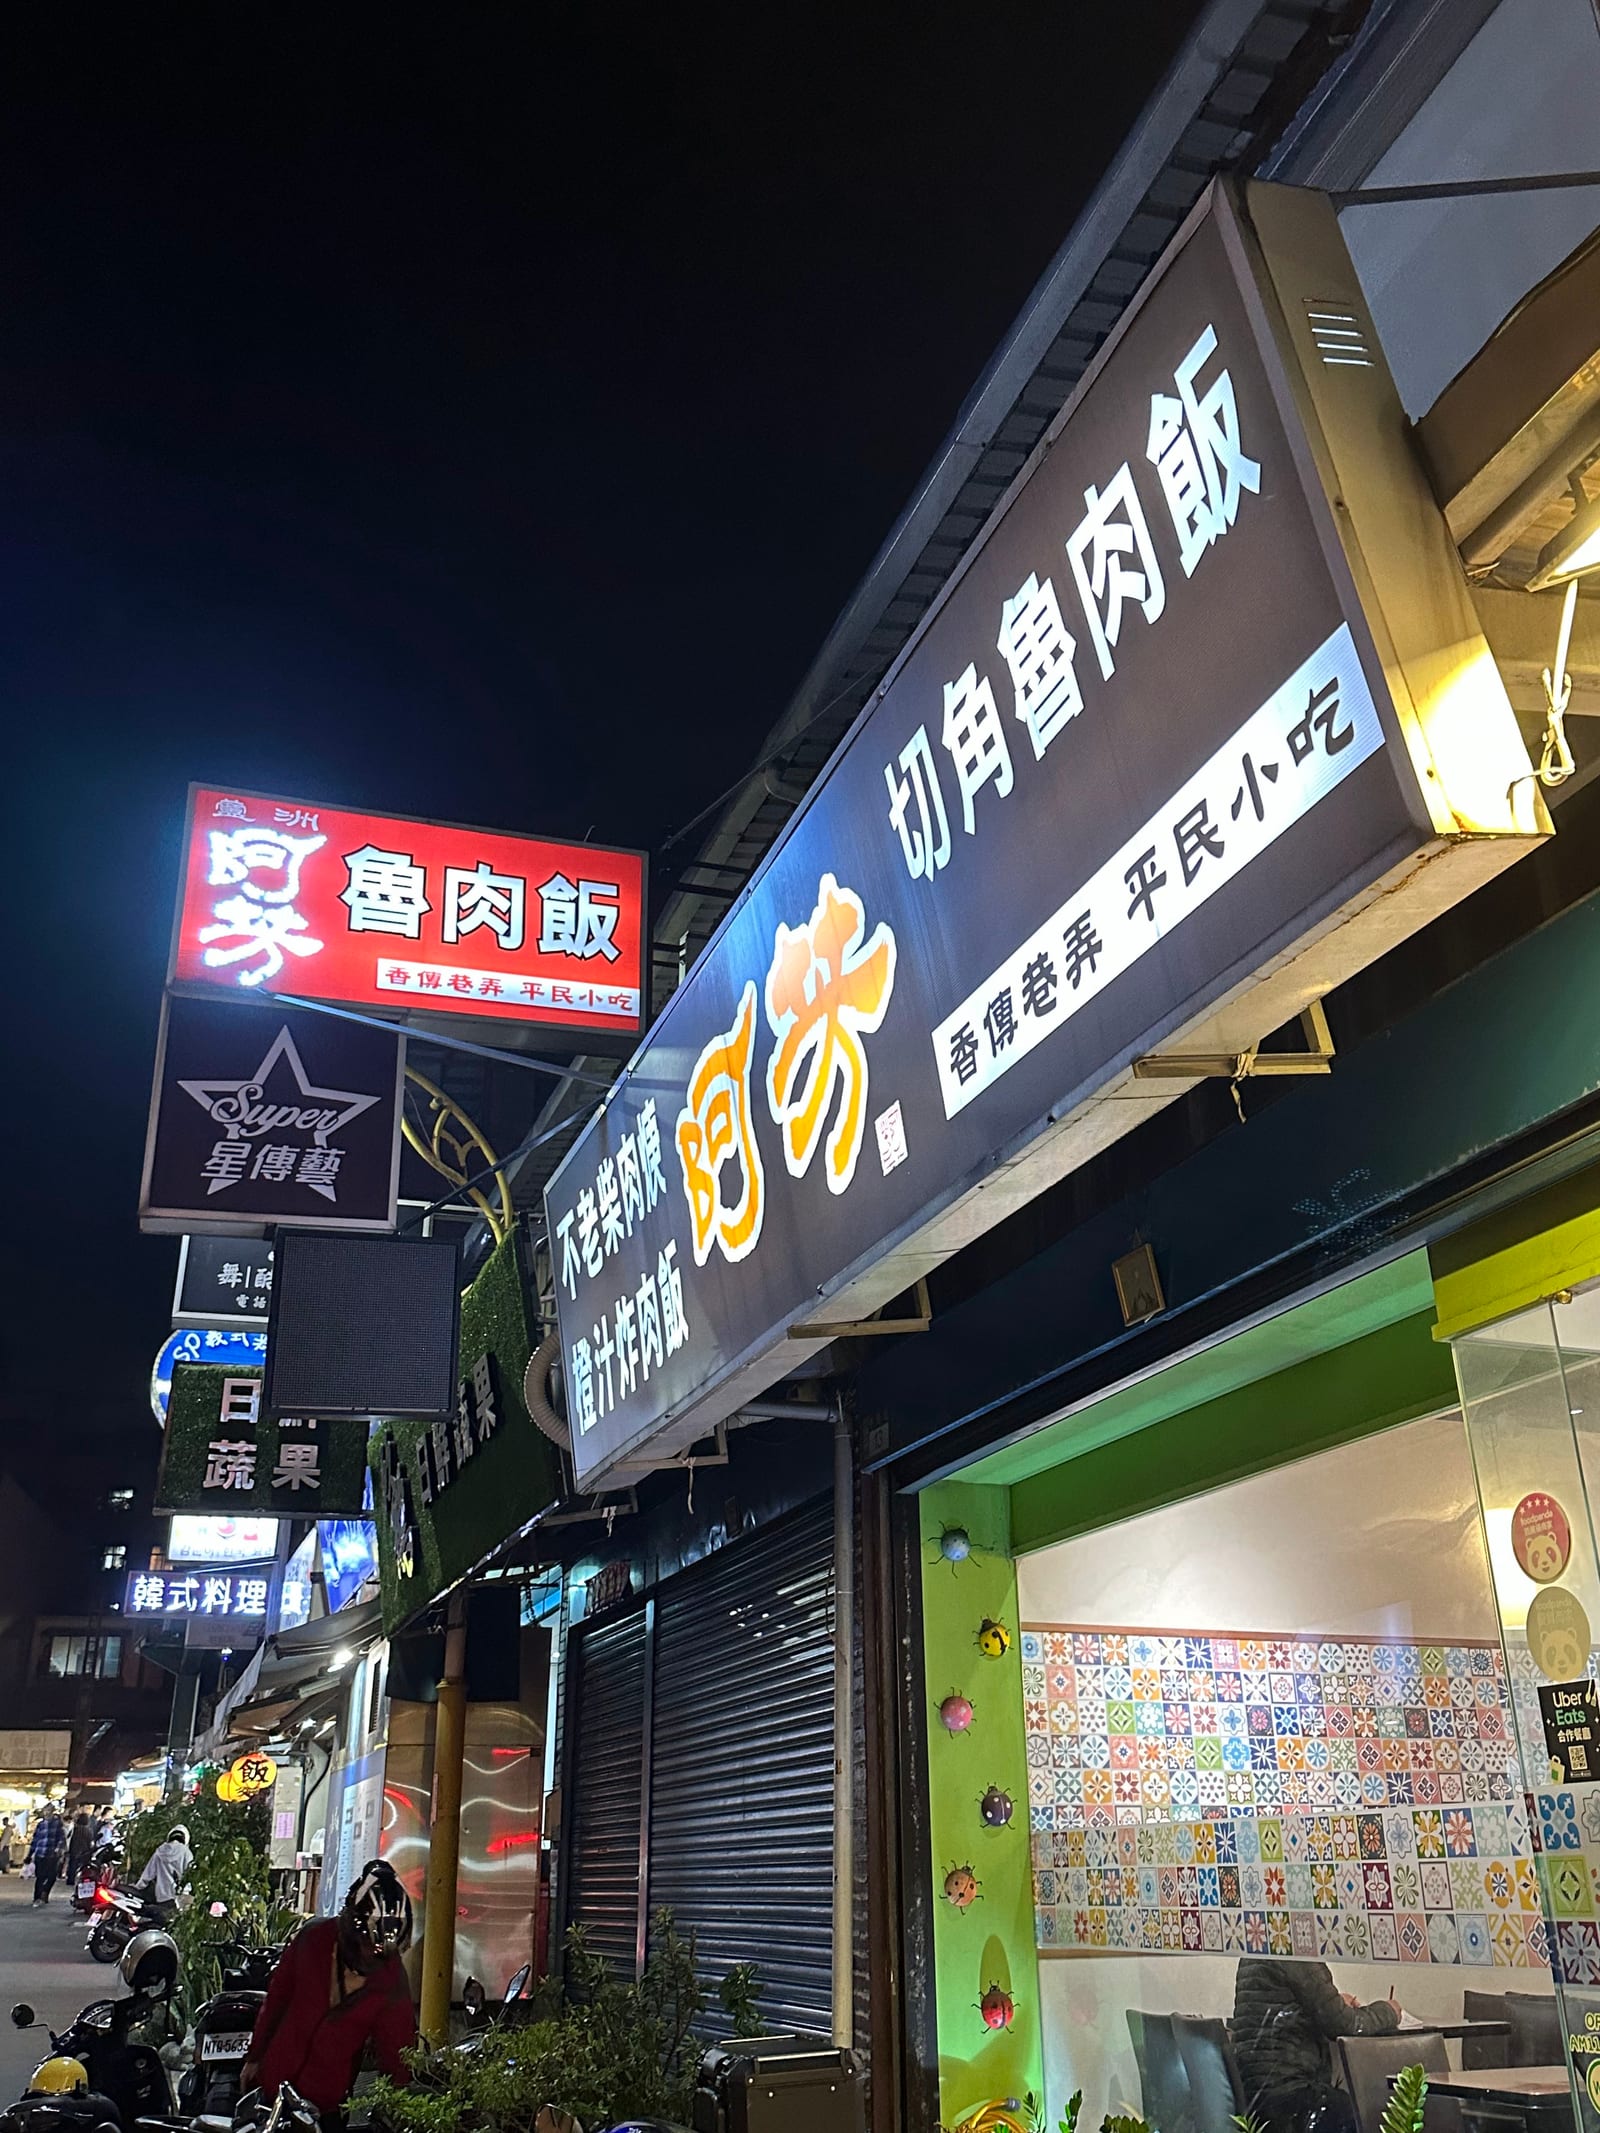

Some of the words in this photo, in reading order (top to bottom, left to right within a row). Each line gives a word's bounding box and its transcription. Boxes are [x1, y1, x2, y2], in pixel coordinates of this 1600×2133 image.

[883, 323, 1262, 883] 切角魯肉飯
[1122, 675, 1356, 922] 平民小吃
[337, 843, 623, 964] 魯肉飯
[519, 981, 634, 1012] 平民小吃
[211, 1083, 339, 1137] Super
[200, 1141, 346, 1185] 星傳藝
[571, 1238, 690, 1437] 橙汁炸肉飯
[203, 1440, 321, 1491] 蔬果
[133, 1574, 268, 1615] 韓式料理
[1552, 1691, 1582, 1708] Uber
[1555, 1708, 1587, 1726] Eats
[237, 1759, 270, 1783] 飯
